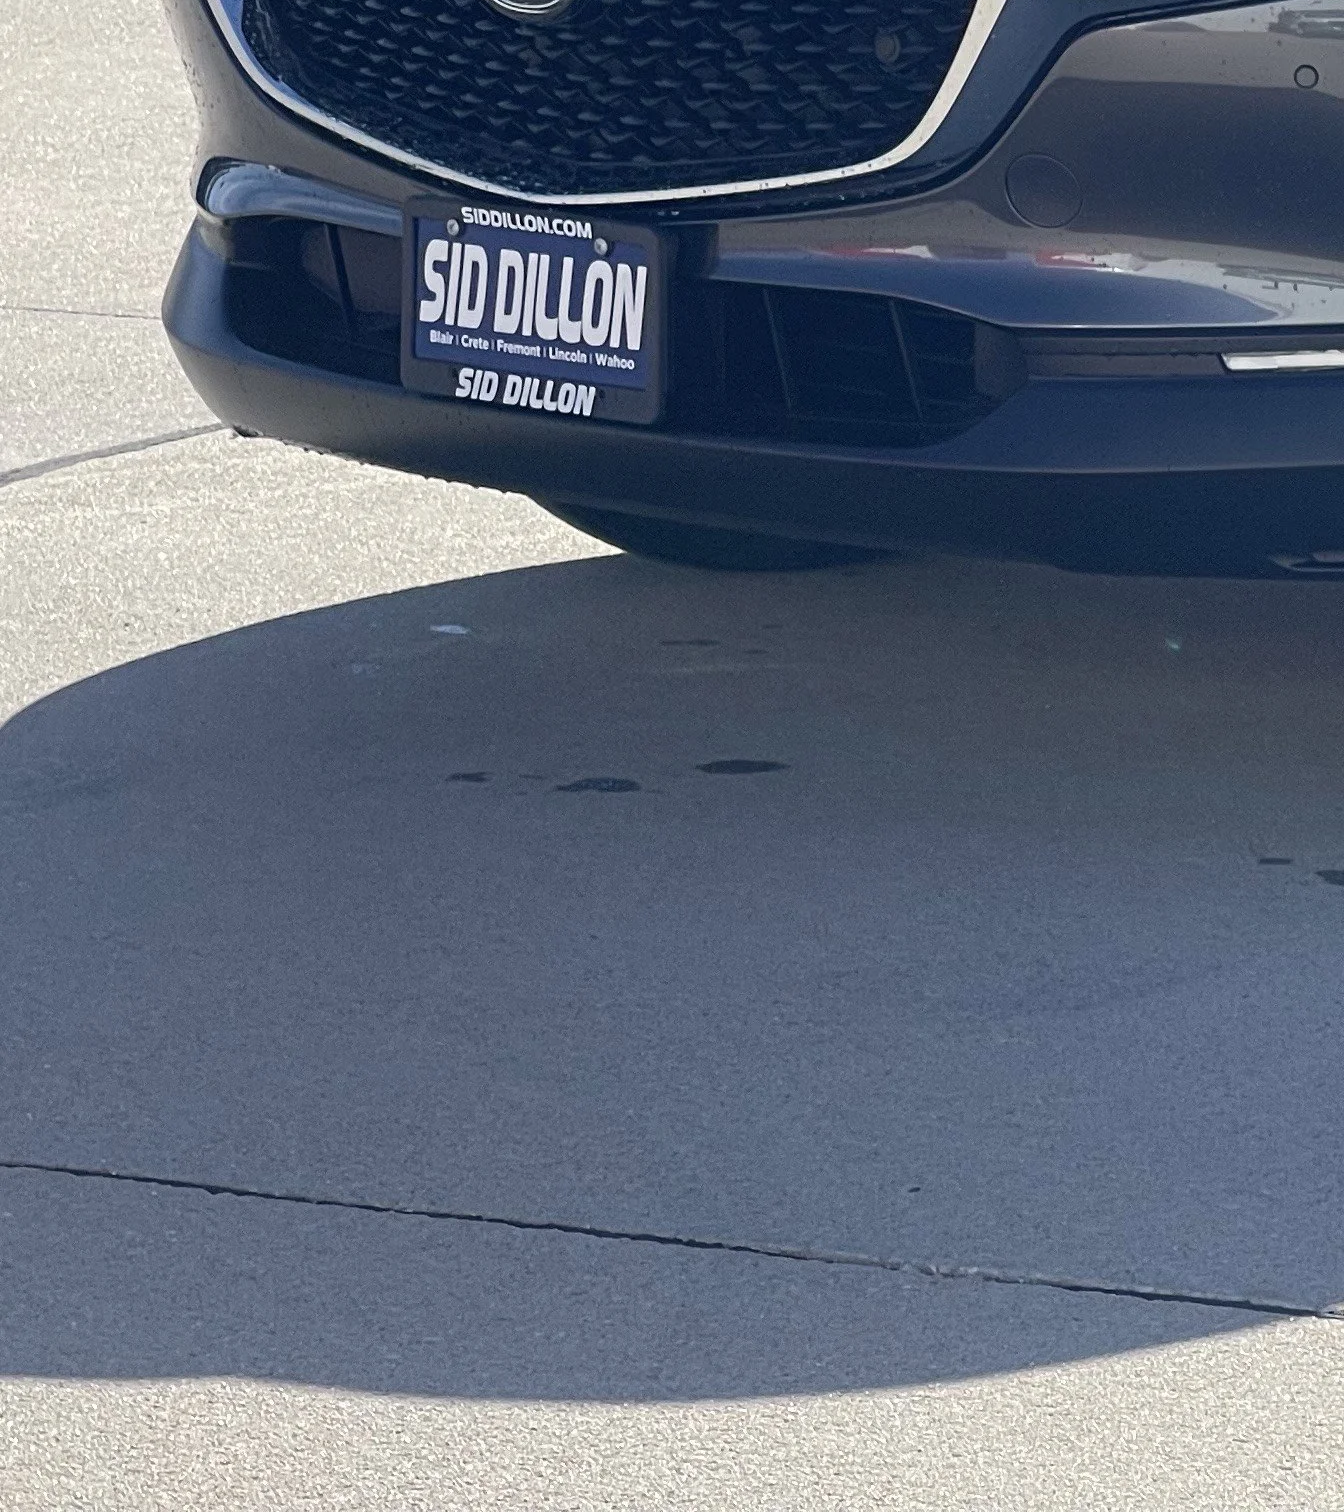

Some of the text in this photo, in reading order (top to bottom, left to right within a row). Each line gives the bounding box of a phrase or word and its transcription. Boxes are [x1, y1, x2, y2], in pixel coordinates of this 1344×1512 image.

[461, 206, 593, 239] SIDDILLON.COM
[419, 238, 648, 351] SID DILLON
[430, 329, 635, 370] Blair Crete Fremont Lincoln Wahoo
[455, 368, 596, 416] SID DILLON
